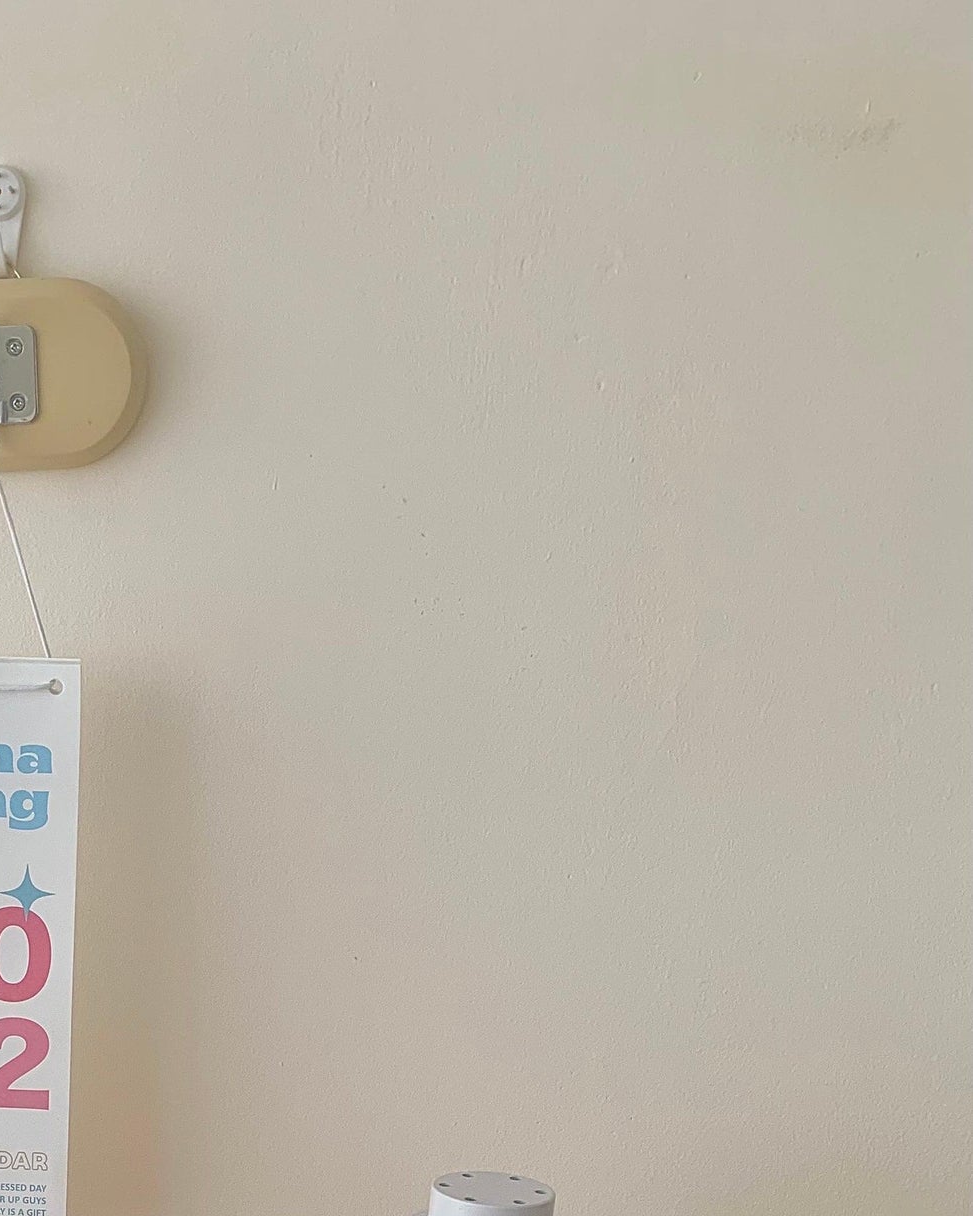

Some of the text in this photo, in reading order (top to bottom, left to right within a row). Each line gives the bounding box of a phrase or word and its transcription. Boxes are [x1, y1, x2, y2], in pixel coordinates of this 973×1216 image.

[30, 1183, 47, 1193] DAY
[8, 1195, 20, 1204] UP
[23, 1196, 47, 1205] GUYS
[8, 1207, 15, 1216] IS
[18, 1208, 24, 1216] A
[27, 1208, 47, 1216] GIFT
